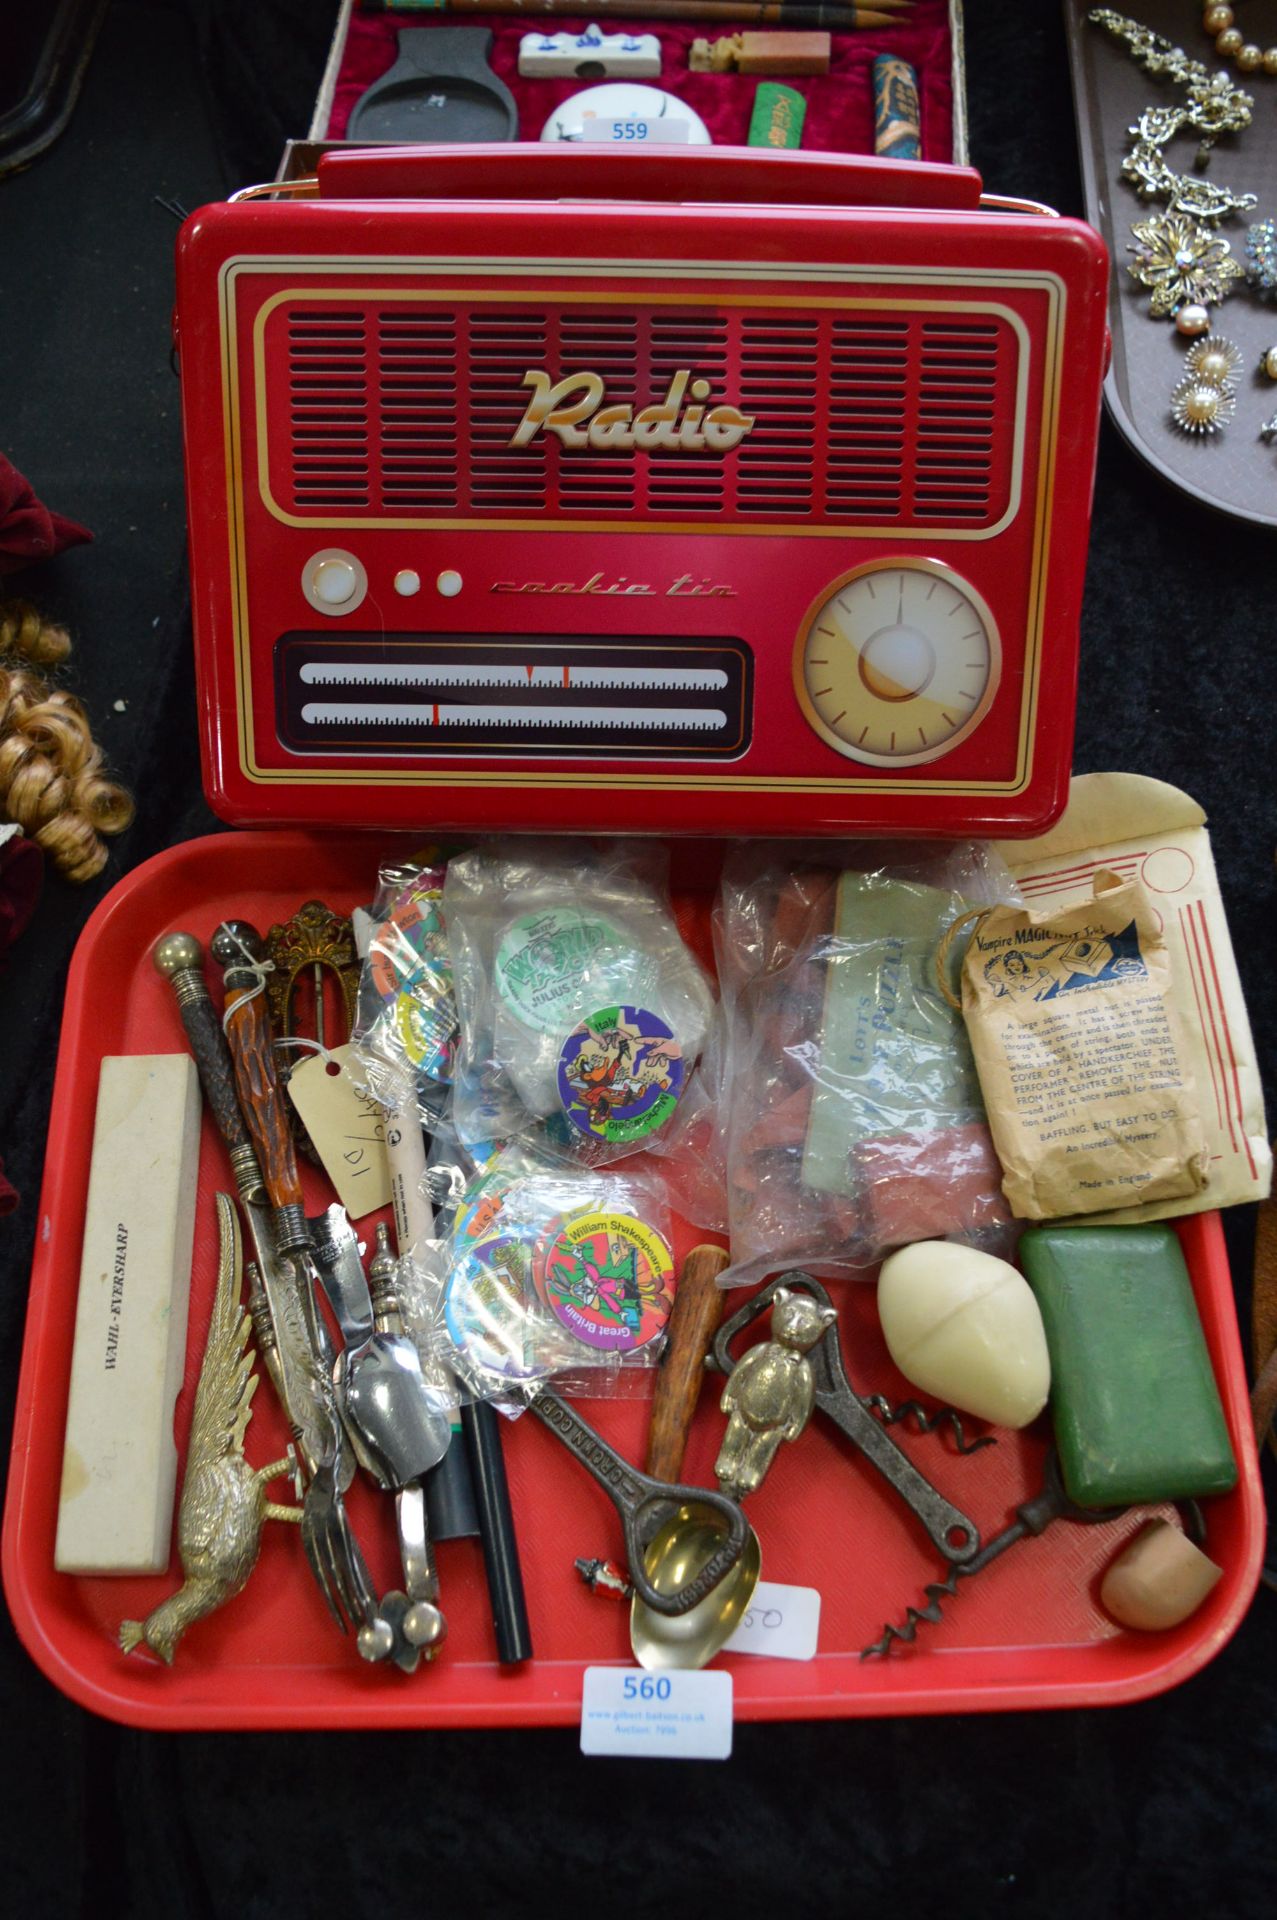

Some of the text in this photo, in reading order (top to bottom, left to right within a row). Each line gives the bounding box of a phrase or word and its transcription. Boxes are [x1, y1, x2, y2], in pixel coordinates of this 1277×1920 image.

[613, 123, 648, 139] 559
[509, 370, 755, 450] Radio
[491, 573, 738, 596] cookie tin
[976, 935, 1013, 951] Vampire
[1015, 927, 1051, 945] MAGIC
[1117, 976, 1149, 985] MYSTERY
[531, 983, 570, 1008] JULIUS
[595, 1018, 617, 1031] Italy
[1018, 1021, 1038, 1030] large
[1043, 1013, 1070, 1024] square
[1076, 1006, 1099, 1016] metal
[1136, 995, 1162, 1006] passed
[1119, 1009, 1142, 1019] screw
[1004, 1042, 1035, 1050] through
[1039, 1039, 1052, 1047] the
[1056, 1030, 1082, 1042] centre
[1087, 1026, 1100, 1034] and
[1133, 1016, 1167, 1026] threaded
[1116, 1031, 1135, 1040] both
[1009, 1062, 1033, 1071] which
[1053, 1054, 1071, 1065] held
[1141, 1036, 1173, 1046] UNDER
[1011, 1072, 1042, 1082] COVER
[1160, 1048, 1176, 1056] THE
[1013, 1058, 1178, 1093] PERFORMER REMOVES THE NUT
[1016, 1069, 1181, 1105] FROM THE CENTRE OF THE STRING
[1080, 1094, 1101, 1102] once
[1104, 1087, 1130, 1099] passed
[1134, 1085, 1146, 1093] for
[1022, 1119, 1039, 1127] tion
[1093, 1121, 1111, 1131] BUT
[1116, 1114, 1138, 1126] EASY
[1144, 1112, 1157, 1121] TO
[1066, 1145, 1078, 1153] An
[569, 1221, 661, 1274] William Shakespeare
[565, 1304, 631, 1337] Great Britain
[575, 1432, 623, 1484] CROWN
[623, 1676, 671, 1700] 560
